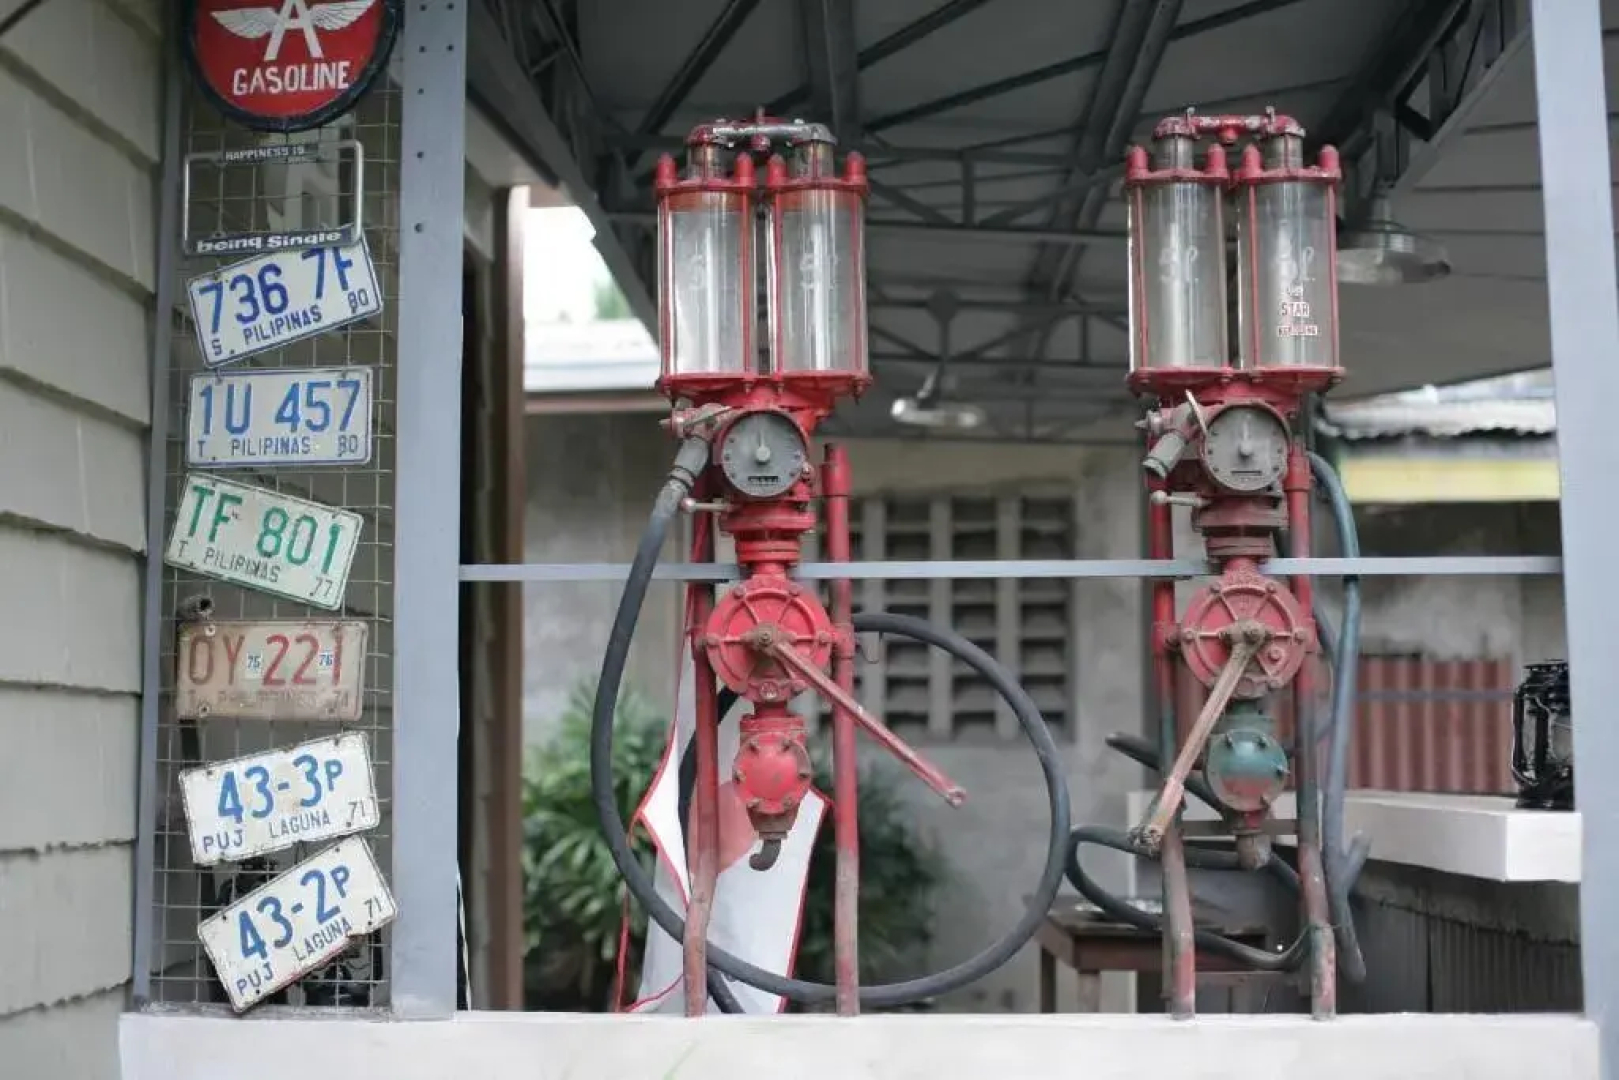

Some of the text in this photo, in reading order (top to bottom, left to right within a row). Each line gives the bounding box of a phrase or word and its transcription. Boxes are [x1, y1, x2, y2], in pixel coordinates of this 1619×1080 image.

[233, 61, 350, 96] GASOLINE
[196, 231, 342, 253] being Single
[199, 263, 289, 334] 736
[1281, 302, 1309, 316] STAR
[243, 305, 322, 345] PILIPINAS
[199, 380, 361, 435] 1U 457
[231, 436, 311, 456] PILIPINAS
[188, 485, 342, 575] TF 801
[203, 547, 281, 583] PILIPINAS
[262, 632, 344, 686] 221
[202, 829, 243, 853] PUJ
[269, 810, 331, 839] LAGUNA
[236, 962, 274, 997] PUJ
[291, 916, 352, 962] LAGUNA
